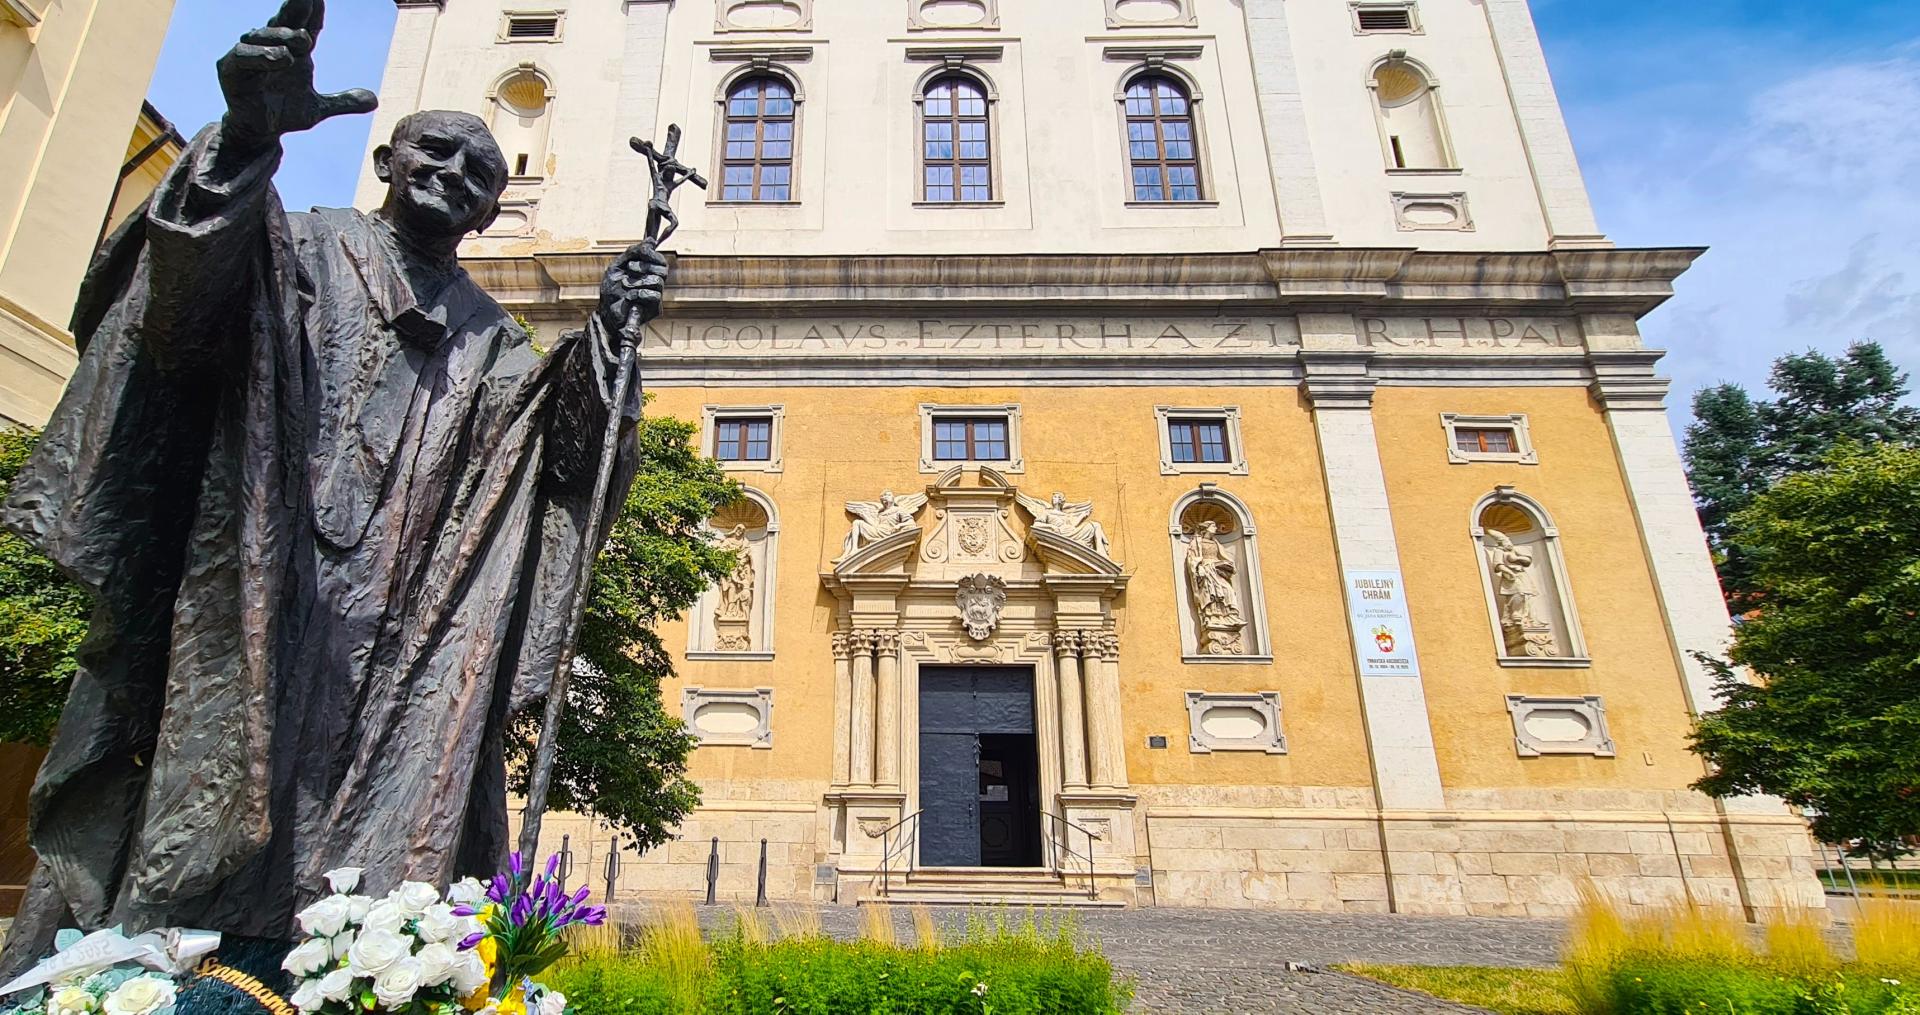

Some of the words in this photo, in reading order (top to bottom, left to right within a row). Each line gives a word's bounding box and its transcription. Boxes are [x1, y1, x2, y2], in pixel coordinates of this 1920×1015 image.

[912, 319, 1281, 350] EZTERHAZI
[1355, 578, 1394, 589] JUBILEJNÝ
[1362, 589, 1391, 600] CHRÁM
